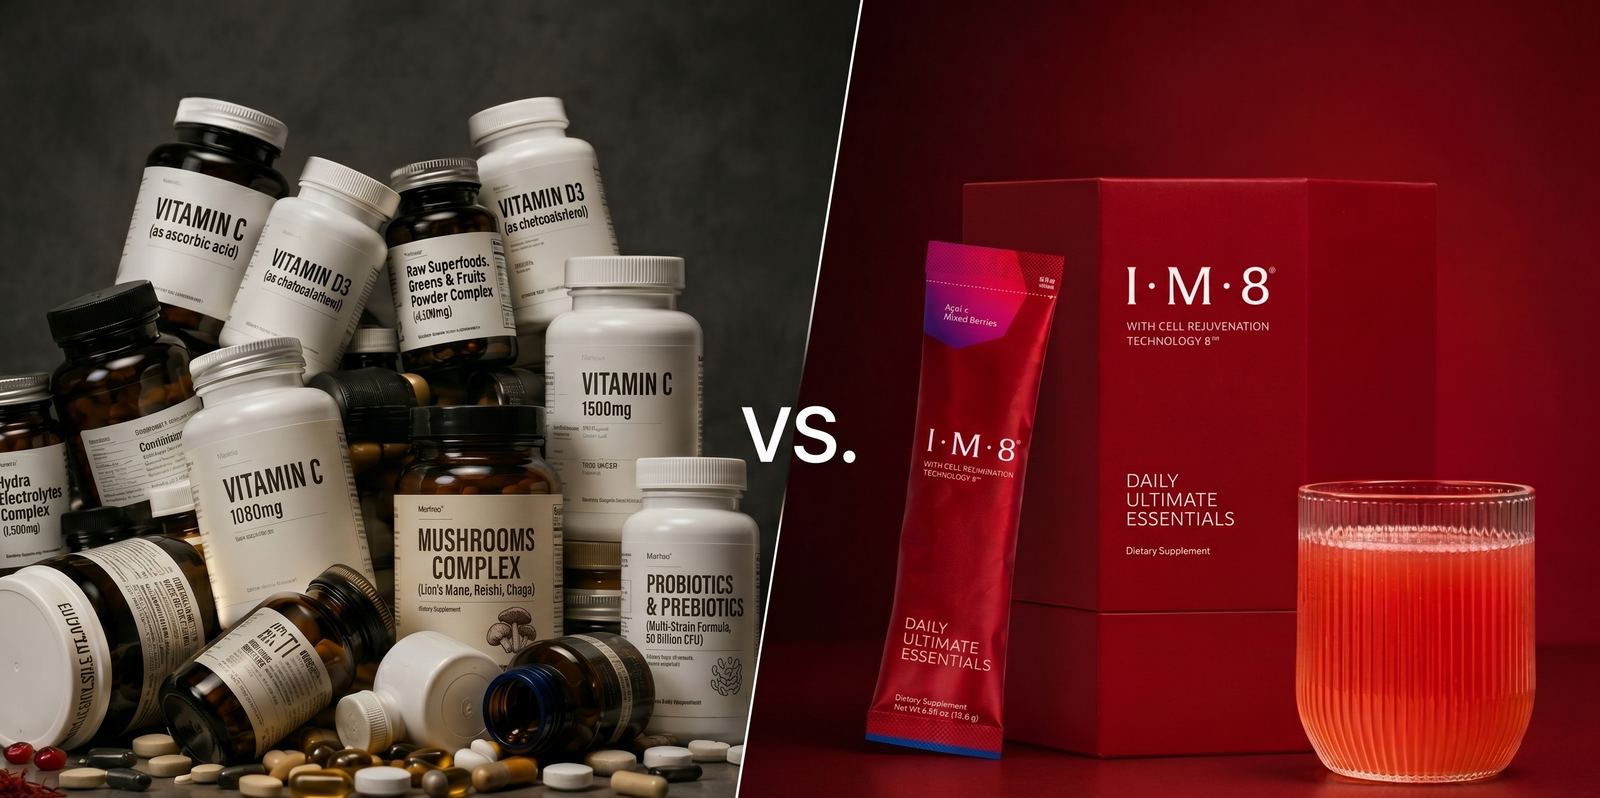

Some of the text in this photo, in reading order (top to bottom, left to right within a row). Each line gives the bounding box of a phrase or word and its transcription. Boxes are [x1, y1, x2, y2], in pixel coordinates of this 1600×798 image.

[498, 182, 584, 218] VITAMIN D3
[156, 197, 247, 241] VITAMIN C
[504, 222, 518, 236] (as
[150, 224, 239, 260] (as ascorbic acid)
[264, 270, 276, 283] (as
[272, 248, 352, 296] VITAMIN D3
[406, 263, 426, 278] Raw
[408, 270, 486, 292] Greens & Fruits
[411, 285, 494, 308] Powder Complex
[944, 313, 998, 328] Mixed Berries
[1126, 322, 1270, 332] WITH CELL REJUVENATION
[1126, 336, 1202, 346] TECHNOLOGY
[582, 372, 672, 396] VITAMIN C
[582, 401, 632, 420] 1500mg
[924, 470, 970, 482] TECHNOLOGY
[944, 463, 961, 472] CELL
[222, 461, 306, 504] VITAMIN
[310, 458, 323, 484] C
[1127, 474, 1179, 488] DAILY
[0, 487, 62, 506] Electrolytes
[1127, 492, 1218, 507] ULTIMATE
[1, 504, 50, 522] Complex
[230, 502, 283, 525] 1080mg
[1127, 512, 1235, 526] ESSENTIALS
[418, 528, 535, 552] MUSHROOMS
[1126, 546, 1210, 556] Dietary Supplement
[432, 556, 522, 580] COMPLEX
[418, 583, 536, 598] (Lion's Mane, Reishi, Chaga)
[647, 574, 734, 594] PROBIOTICS
[646, 597, 744, 618] & PREBIOTICS
[646, 620, 732, 634] (Multi-Strain Formula,
[905, 617, 948, 634] DAILY
[646, 634, 704, 646] 50 Billion CFU)
[903, 632, 980, 654] ULTIMATE
[901, 648, 991, 672] ESSENTIALS
[922, 698, 967, 710] Supplement
[894, 704, 908, 712] Net
[910, 706, 920, 714] Wt
[970, 714, 979, 723] g)
